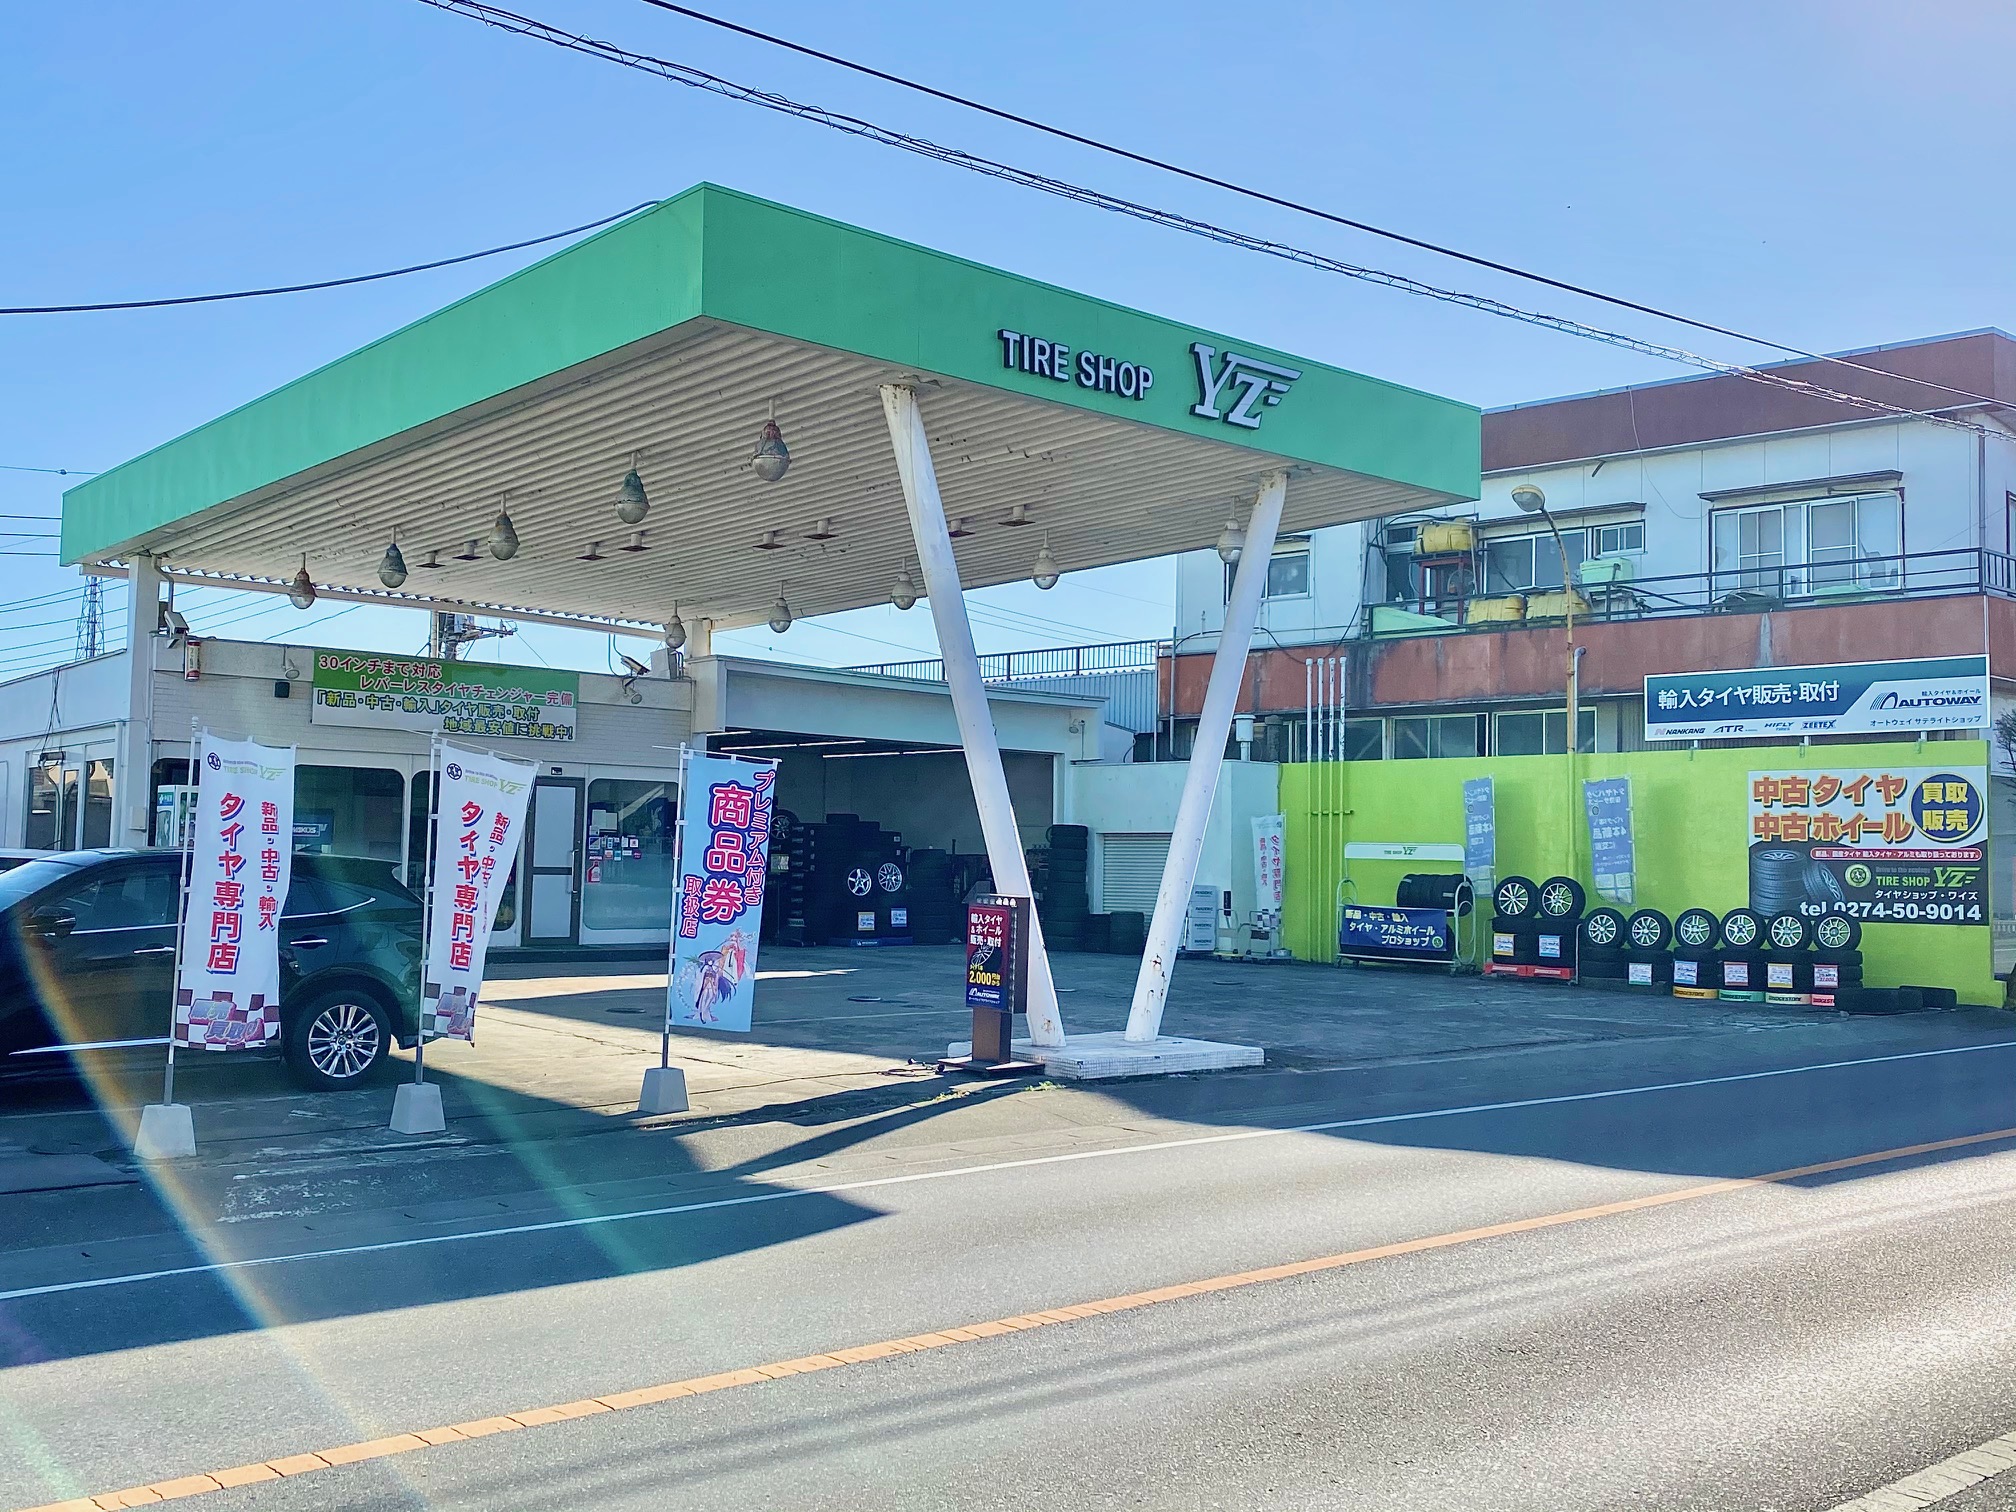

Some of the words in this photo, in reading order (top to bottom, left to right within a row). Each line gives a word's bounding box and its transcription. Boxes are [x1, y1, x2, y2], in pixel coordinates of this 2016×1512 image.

[999, 330, 1070, 382] TIRE
[1077, 351, 1153, 400] SHOP
[318, 656, 443, 680] 30インチまで対応
[359, 675, 573, 706] レバーレスタイヤチェンジャー完備
[1658, 681, 1840, 710] 輸入タイヤ販売・取付
[1898, 696, 1982, 707] AUTOWAY
[1665, 727, 1706, 736] NANKANG
[1802, 719, 1837, 730] ZEETEX
[1753, 774, 1907, 807] 中古タイヤ
[1921, 781, 1968, 804] 買取
[1753, 812, 1913, 842] 中古ホイール
[1921, 809, 1969, 832] 販売
[743, 771, 776, 906] プレミアム付き
[701, 784, 754, 923] 商品券
[206, 793, 245, 974] タイヤ専門店
[449, 801, 484, 972] タイヤ専門店
[1876, 876, 1900, 886] TIRE
[1902, 876, 1930, 887] SHOP
[680, 876, 702, 938] 取扱店
[1874, 890, 1978, 901] タイヤショップ・ワイズ
[1800, 900, 1827, 917] tel
[1833, 902, 1982, 921] 0274-50-9014
[1349, 921, 1436, 936] タイヤ・アルミホイール
[1381, 935, 1430, 946] プロショップ
